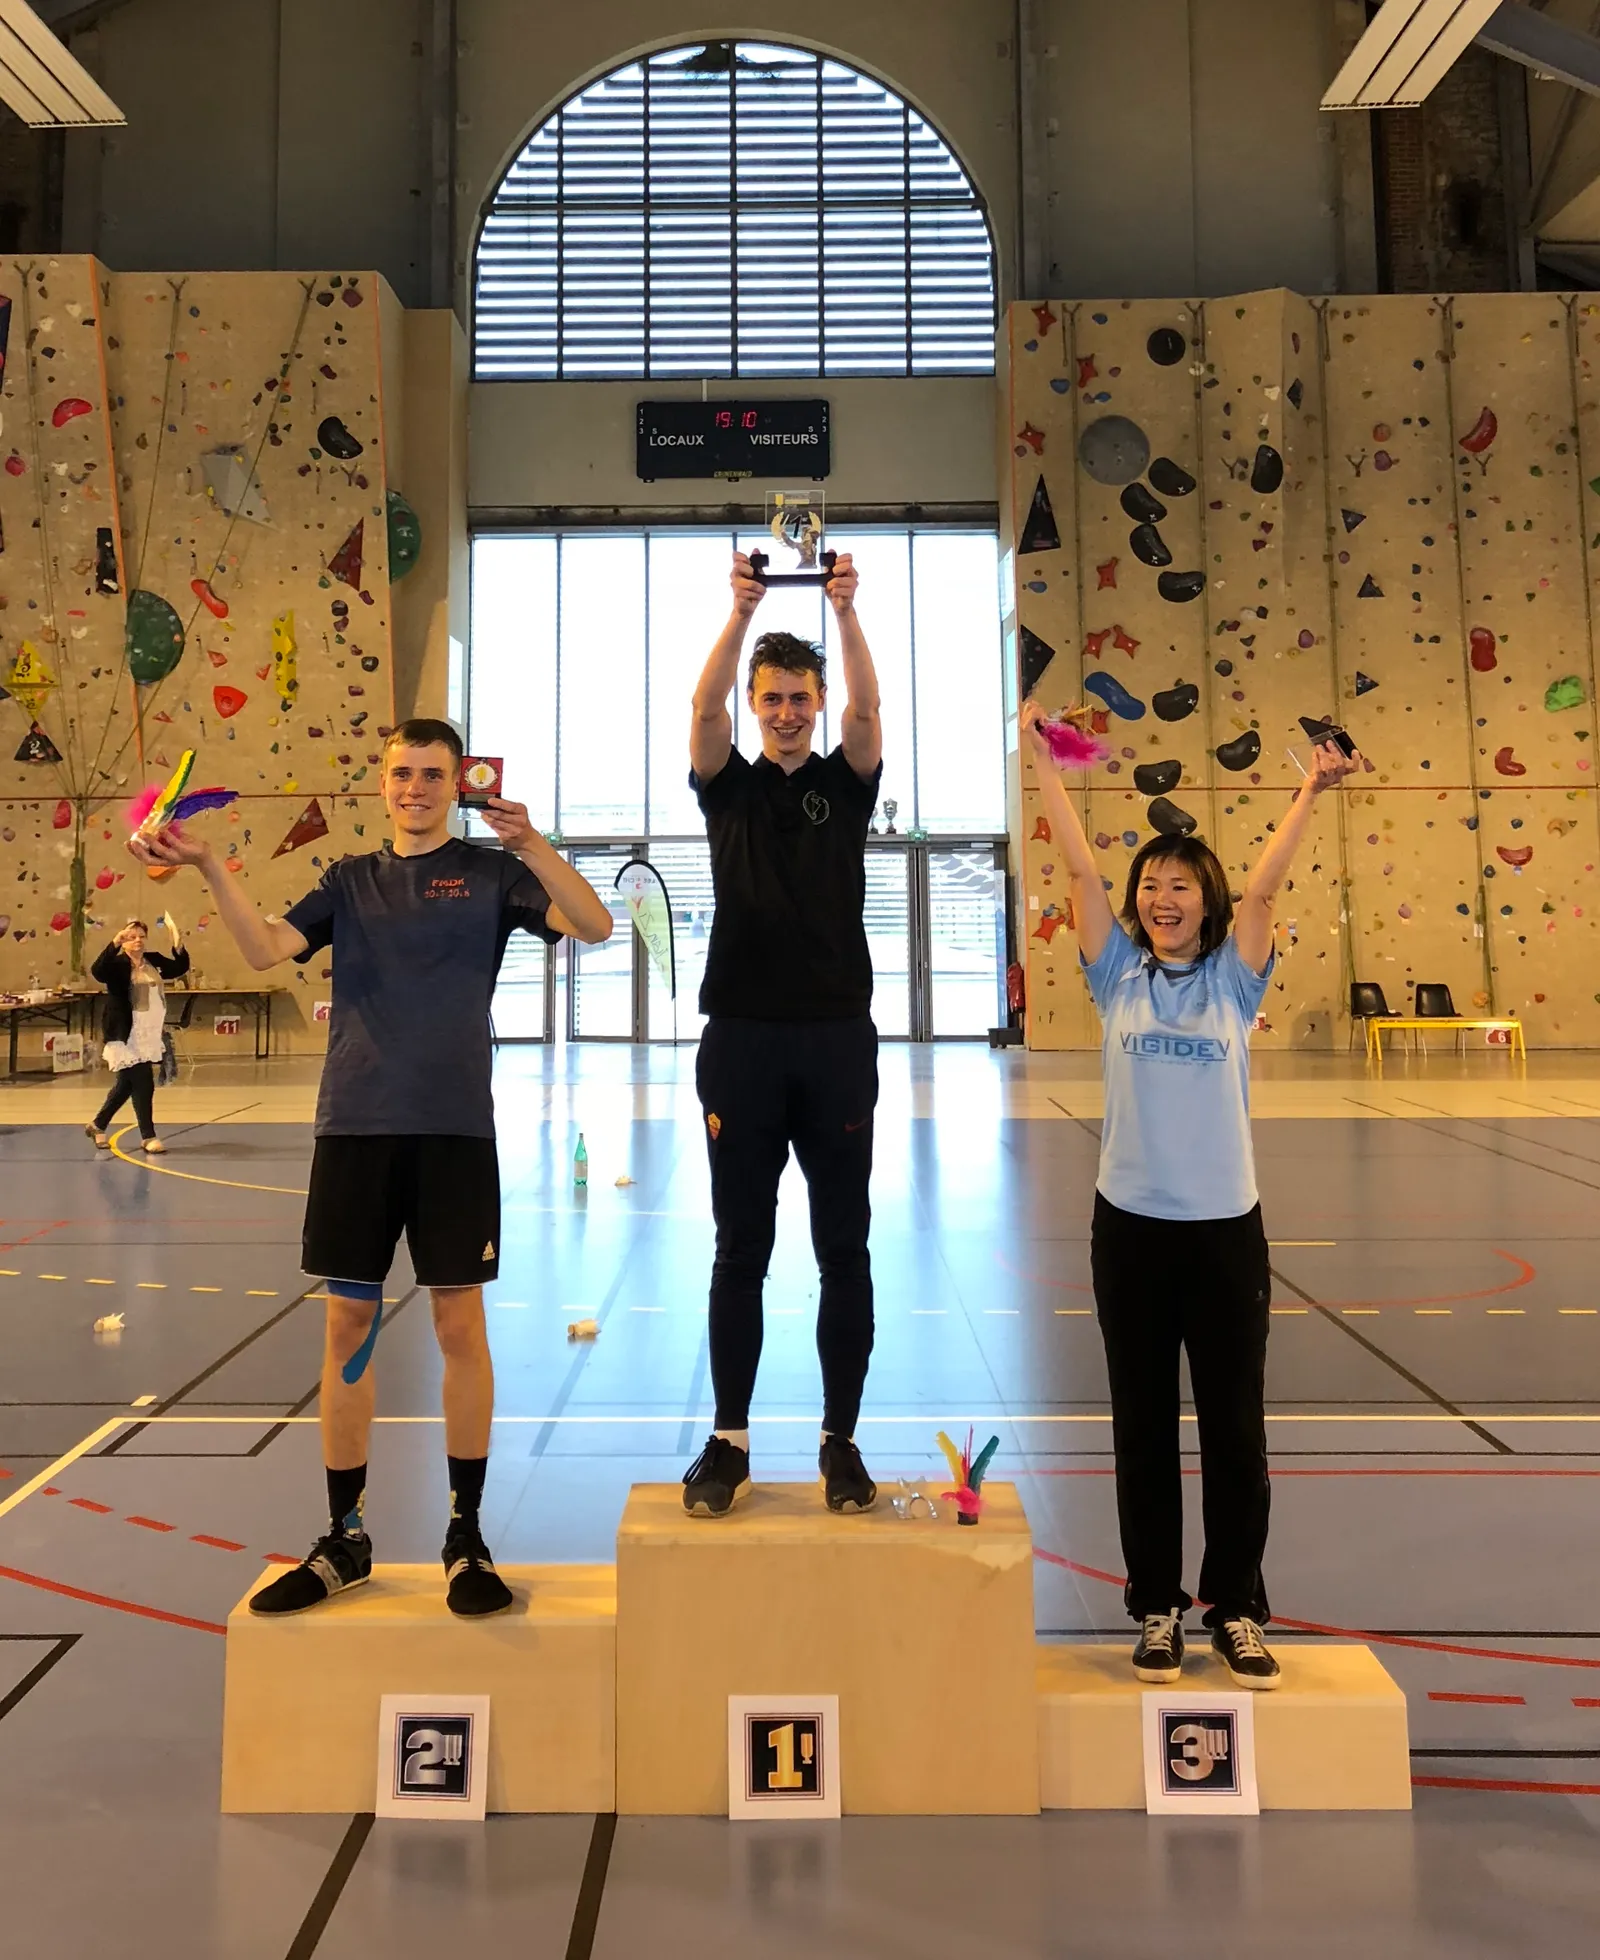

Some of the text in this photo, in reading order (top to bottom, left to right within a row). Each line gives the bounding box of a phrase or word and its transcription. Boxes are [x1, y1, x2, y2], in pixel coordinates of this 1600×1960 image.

[650, 434, 704, 447] LOCAUX
[750, 433, 819, 445] VISITEURS
[223, 1021, 237, 1034] 11
[1498, 1032, 1506, 1043] 6
[1120, 1031, 1231, 1058] VIGIDEV
[404, 1728, 446, 1785] 2
[768, 1722, 803, 1789] 1
[1170, 1723, 1214, 1781] 3
